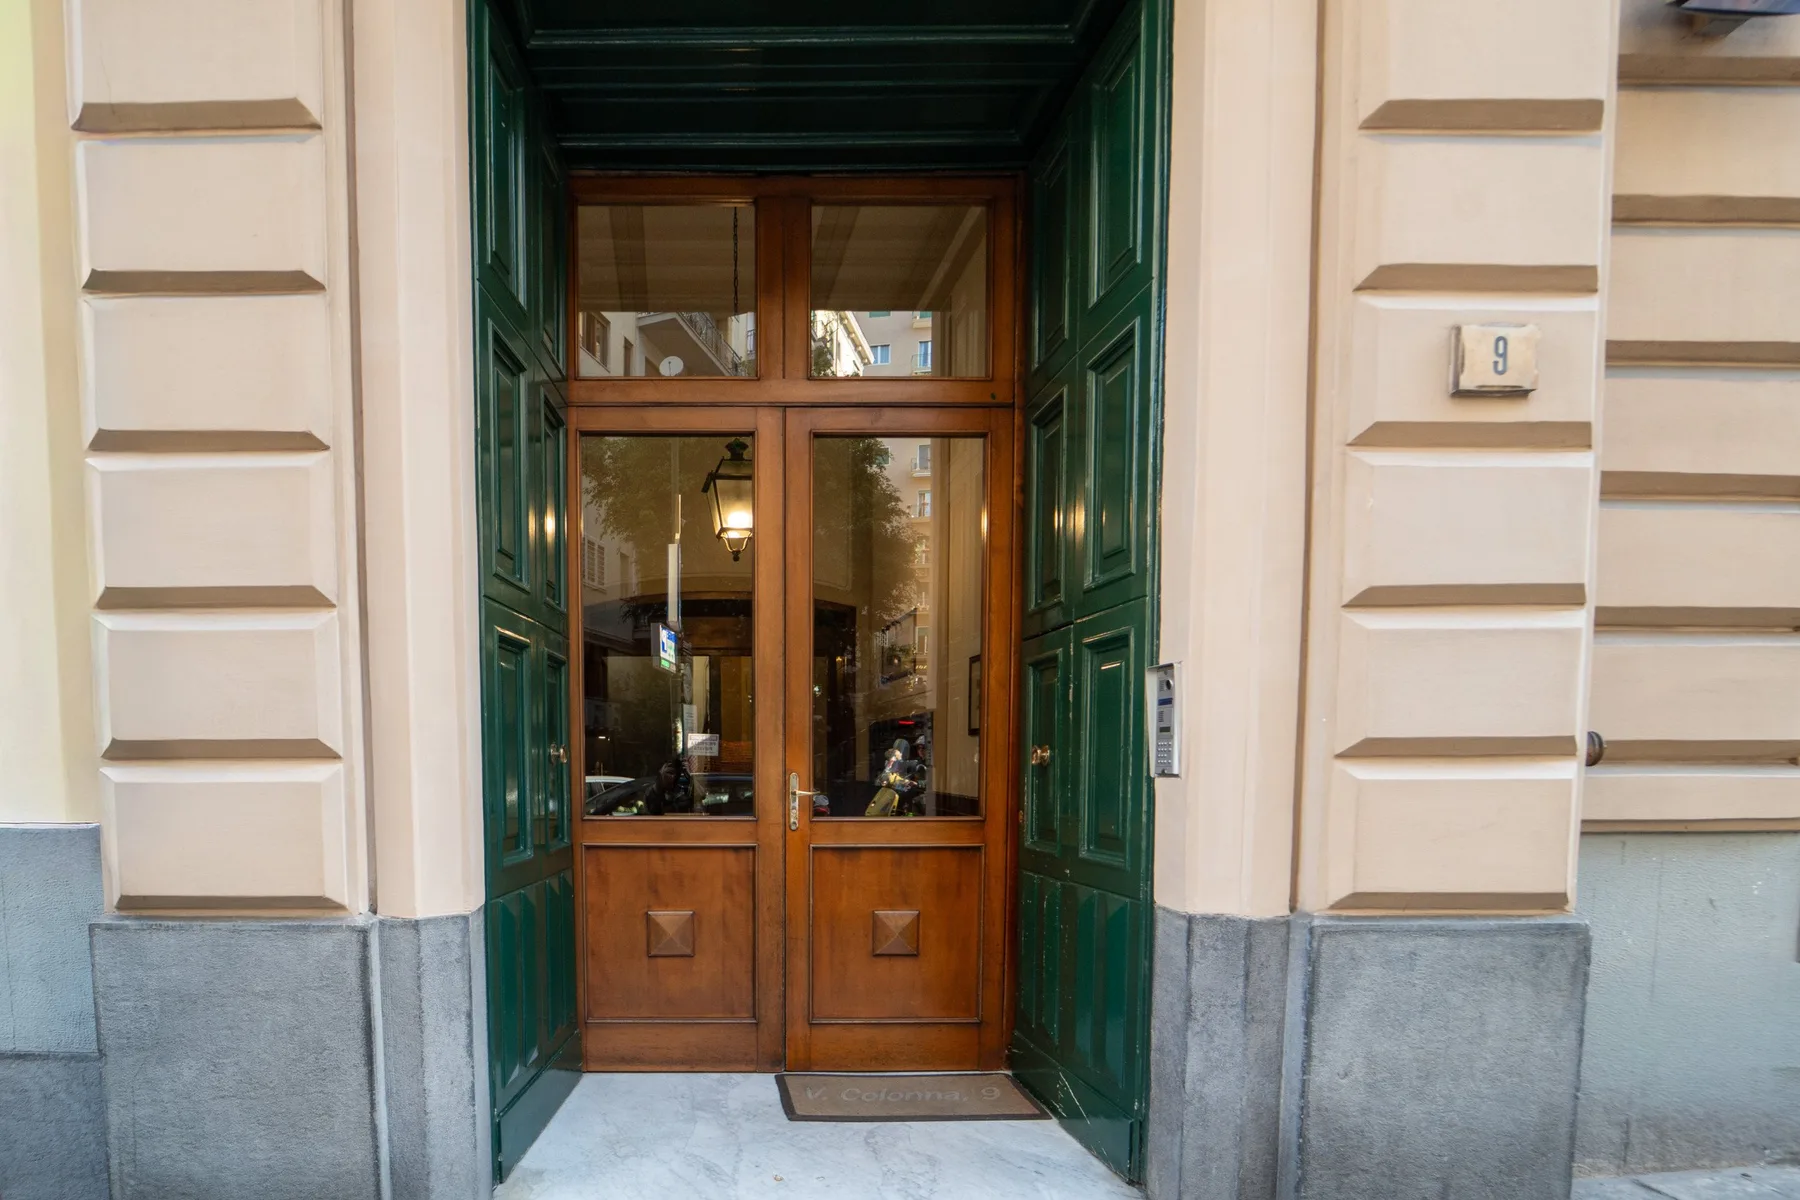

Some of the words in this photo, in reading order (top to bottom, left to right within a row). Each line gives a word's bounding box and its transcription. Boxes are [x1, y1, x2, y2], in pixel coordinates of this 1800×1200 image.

[1492, 335, 1508, 376] 9
[805, 1086, 828, 1100] V.
[980, 1086, 1001, 1101] 9
